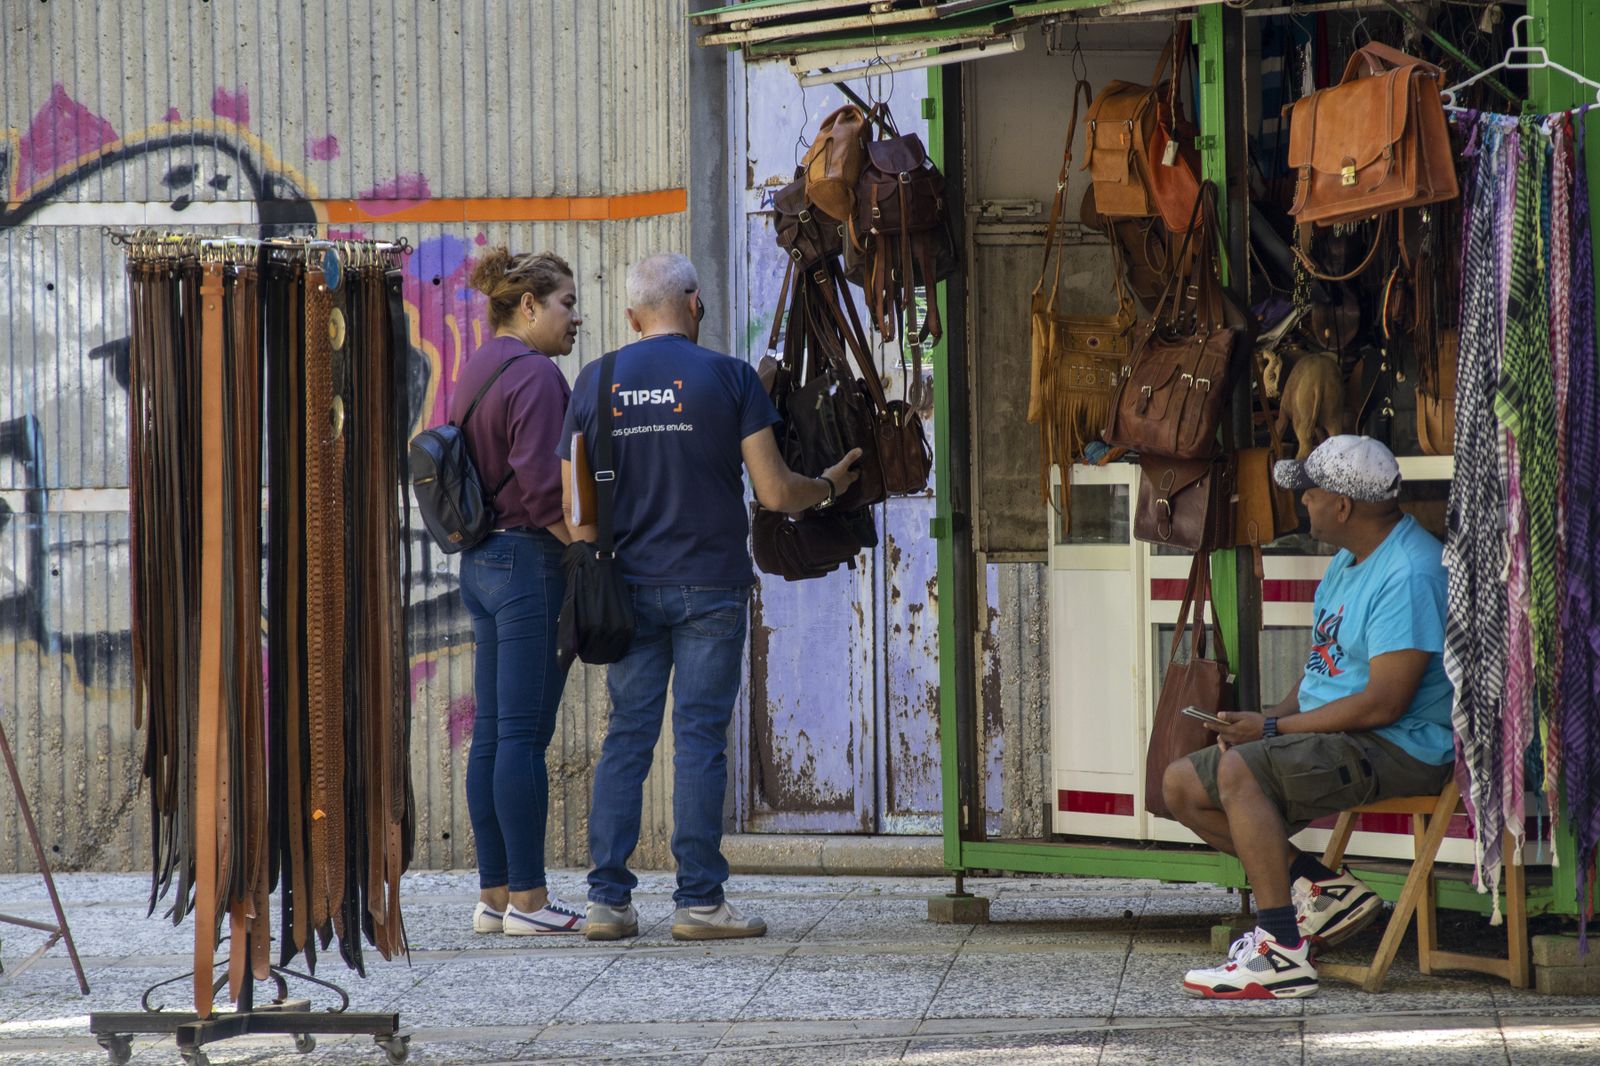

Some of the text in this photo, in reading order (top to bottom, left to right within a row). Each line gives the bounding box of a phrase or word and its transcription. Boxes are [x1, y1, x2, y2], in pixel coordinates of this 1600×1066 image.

[618, 388, 675, 406] TIPSA
[623, 424, 652, 436] gustan
[652, 423, 665, 432] tus
[666, 422, 693, 432] envíos
